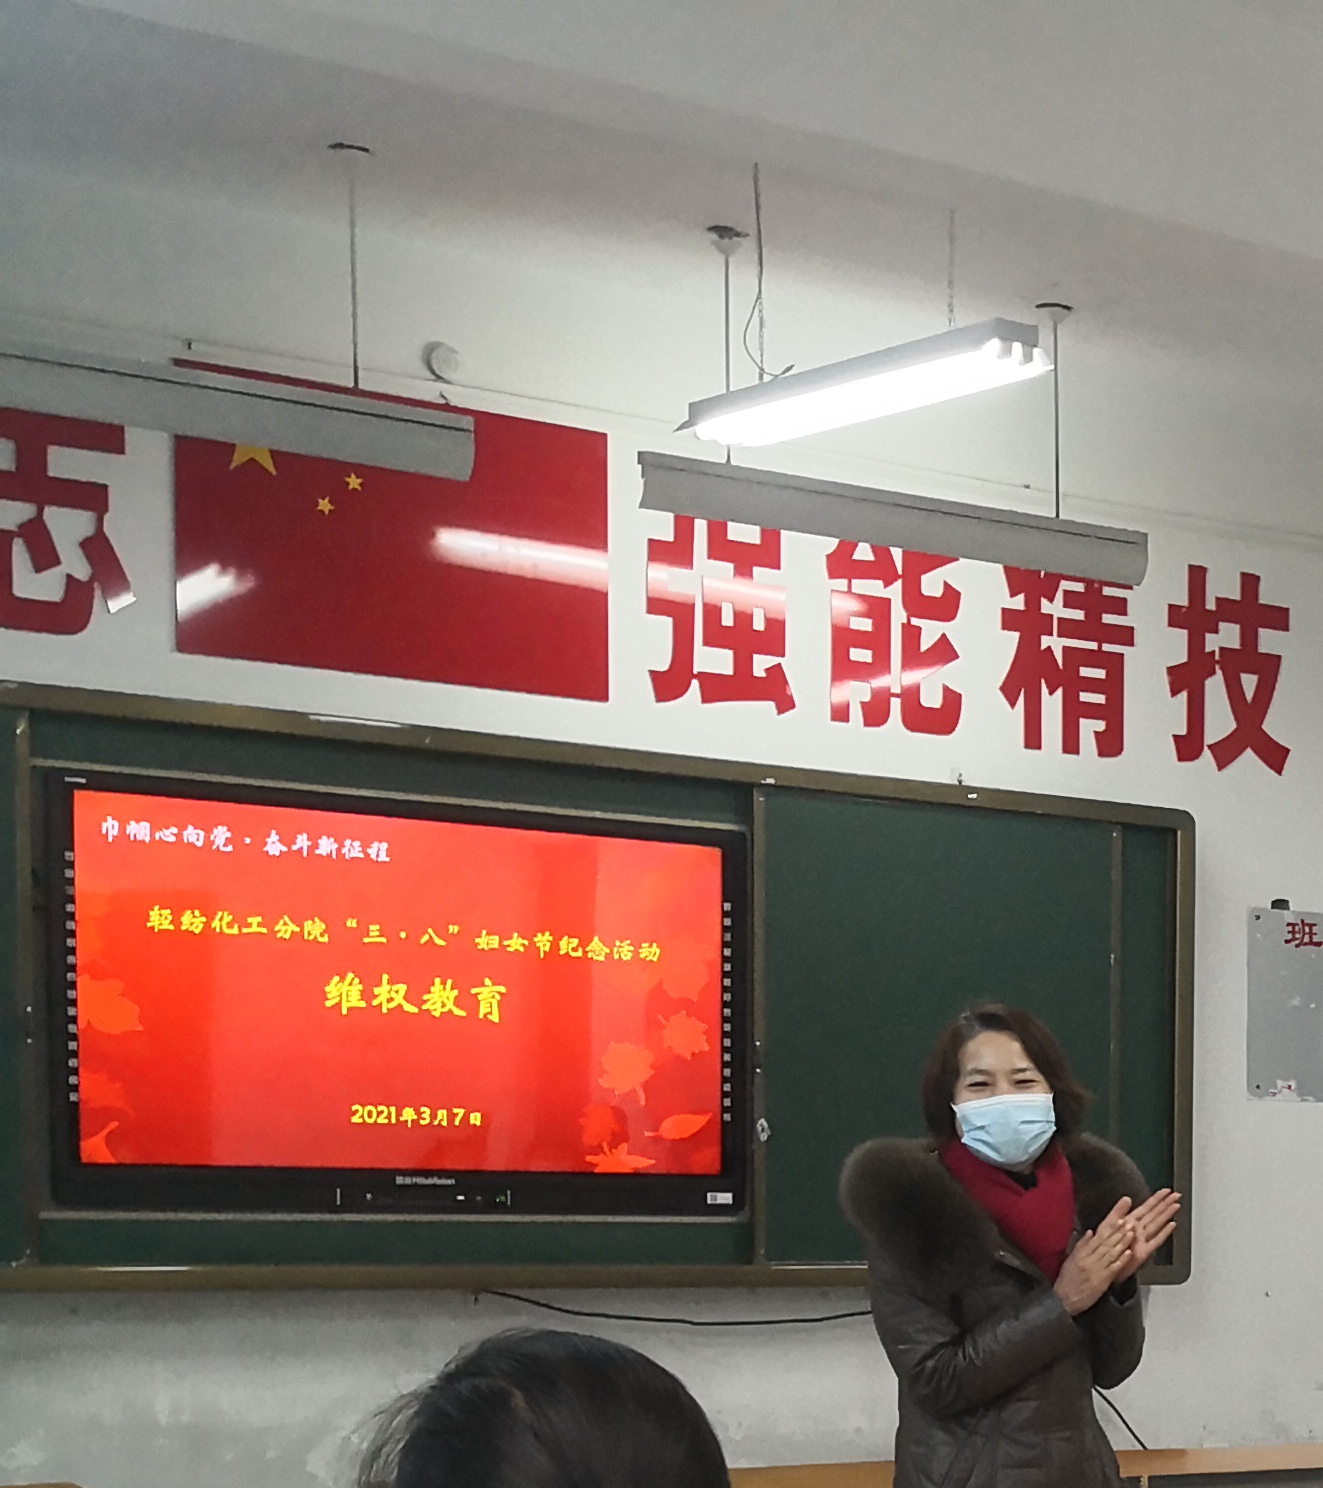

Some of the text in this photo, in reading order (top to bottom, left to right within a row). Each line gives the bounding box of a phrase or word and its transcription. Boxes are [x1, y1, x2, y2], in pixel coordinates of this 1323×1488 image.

[646, 513, 1291, 777] 强能精技
[324, 972, 507, 1023] 维权教育
[350, 1104, 482, 1128] 2021年3月7日
